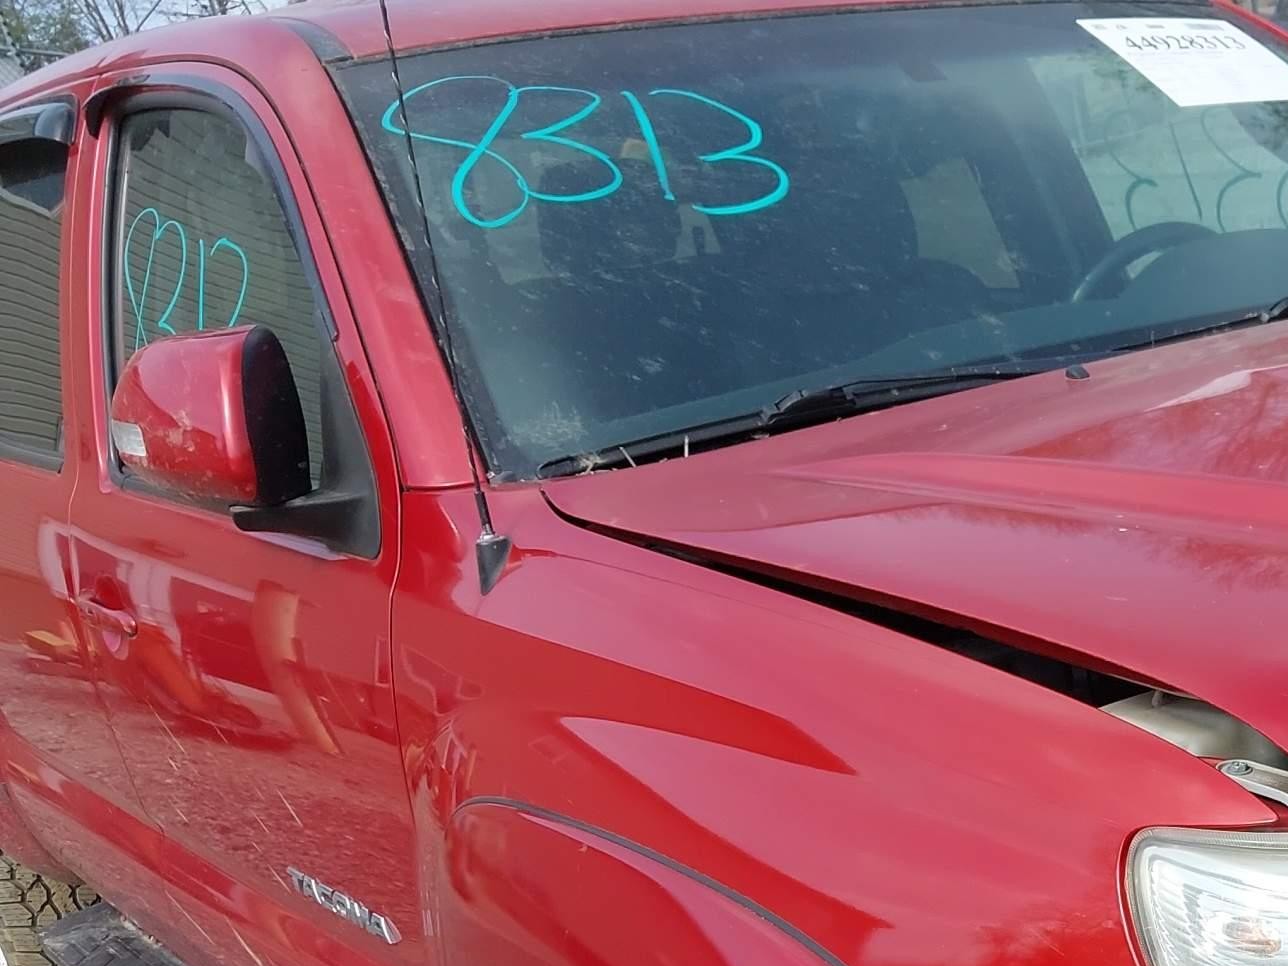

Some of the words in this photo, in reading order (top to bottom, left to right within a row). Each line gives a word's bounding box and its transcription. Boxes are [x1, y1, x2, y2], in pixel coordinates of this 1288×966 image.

[1125, 35, 1247, 51] 44928313
[382, 75, 790, 228] 8313
[286, 865, 402, 945] TACOMA
